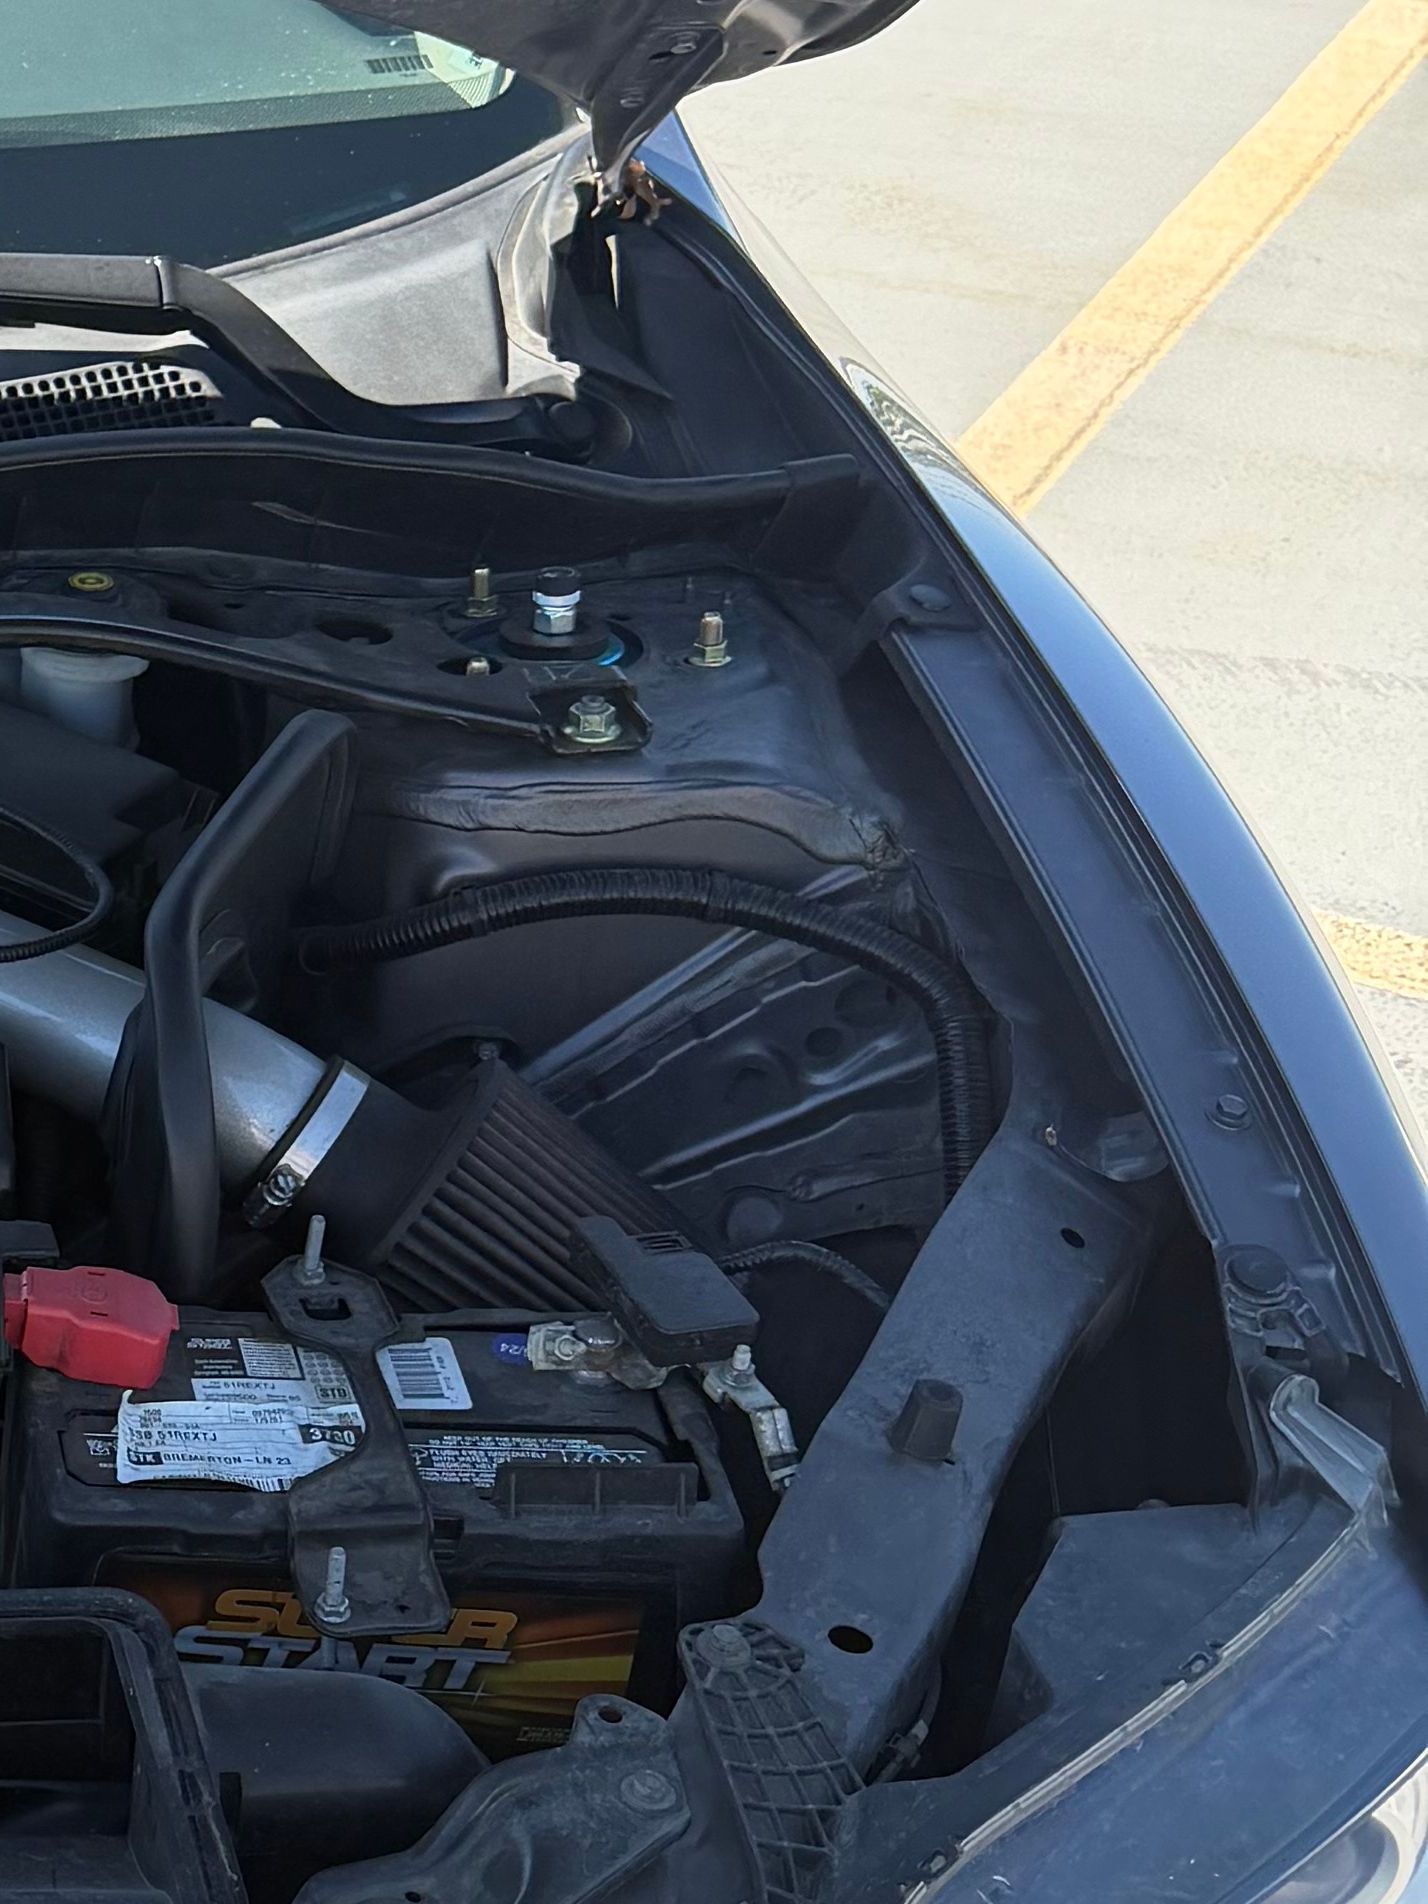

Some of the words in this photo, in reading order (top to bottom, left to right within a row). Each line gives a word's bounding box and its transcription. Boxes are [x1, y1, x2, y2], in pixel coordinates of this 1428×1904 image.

[320, 1387, 347, 1398] STD
[164, 1452, 242, 1465] BREMERTON
[205, 1588, 519, 1649] SUR
[173, 1624, 513, 1690] START
